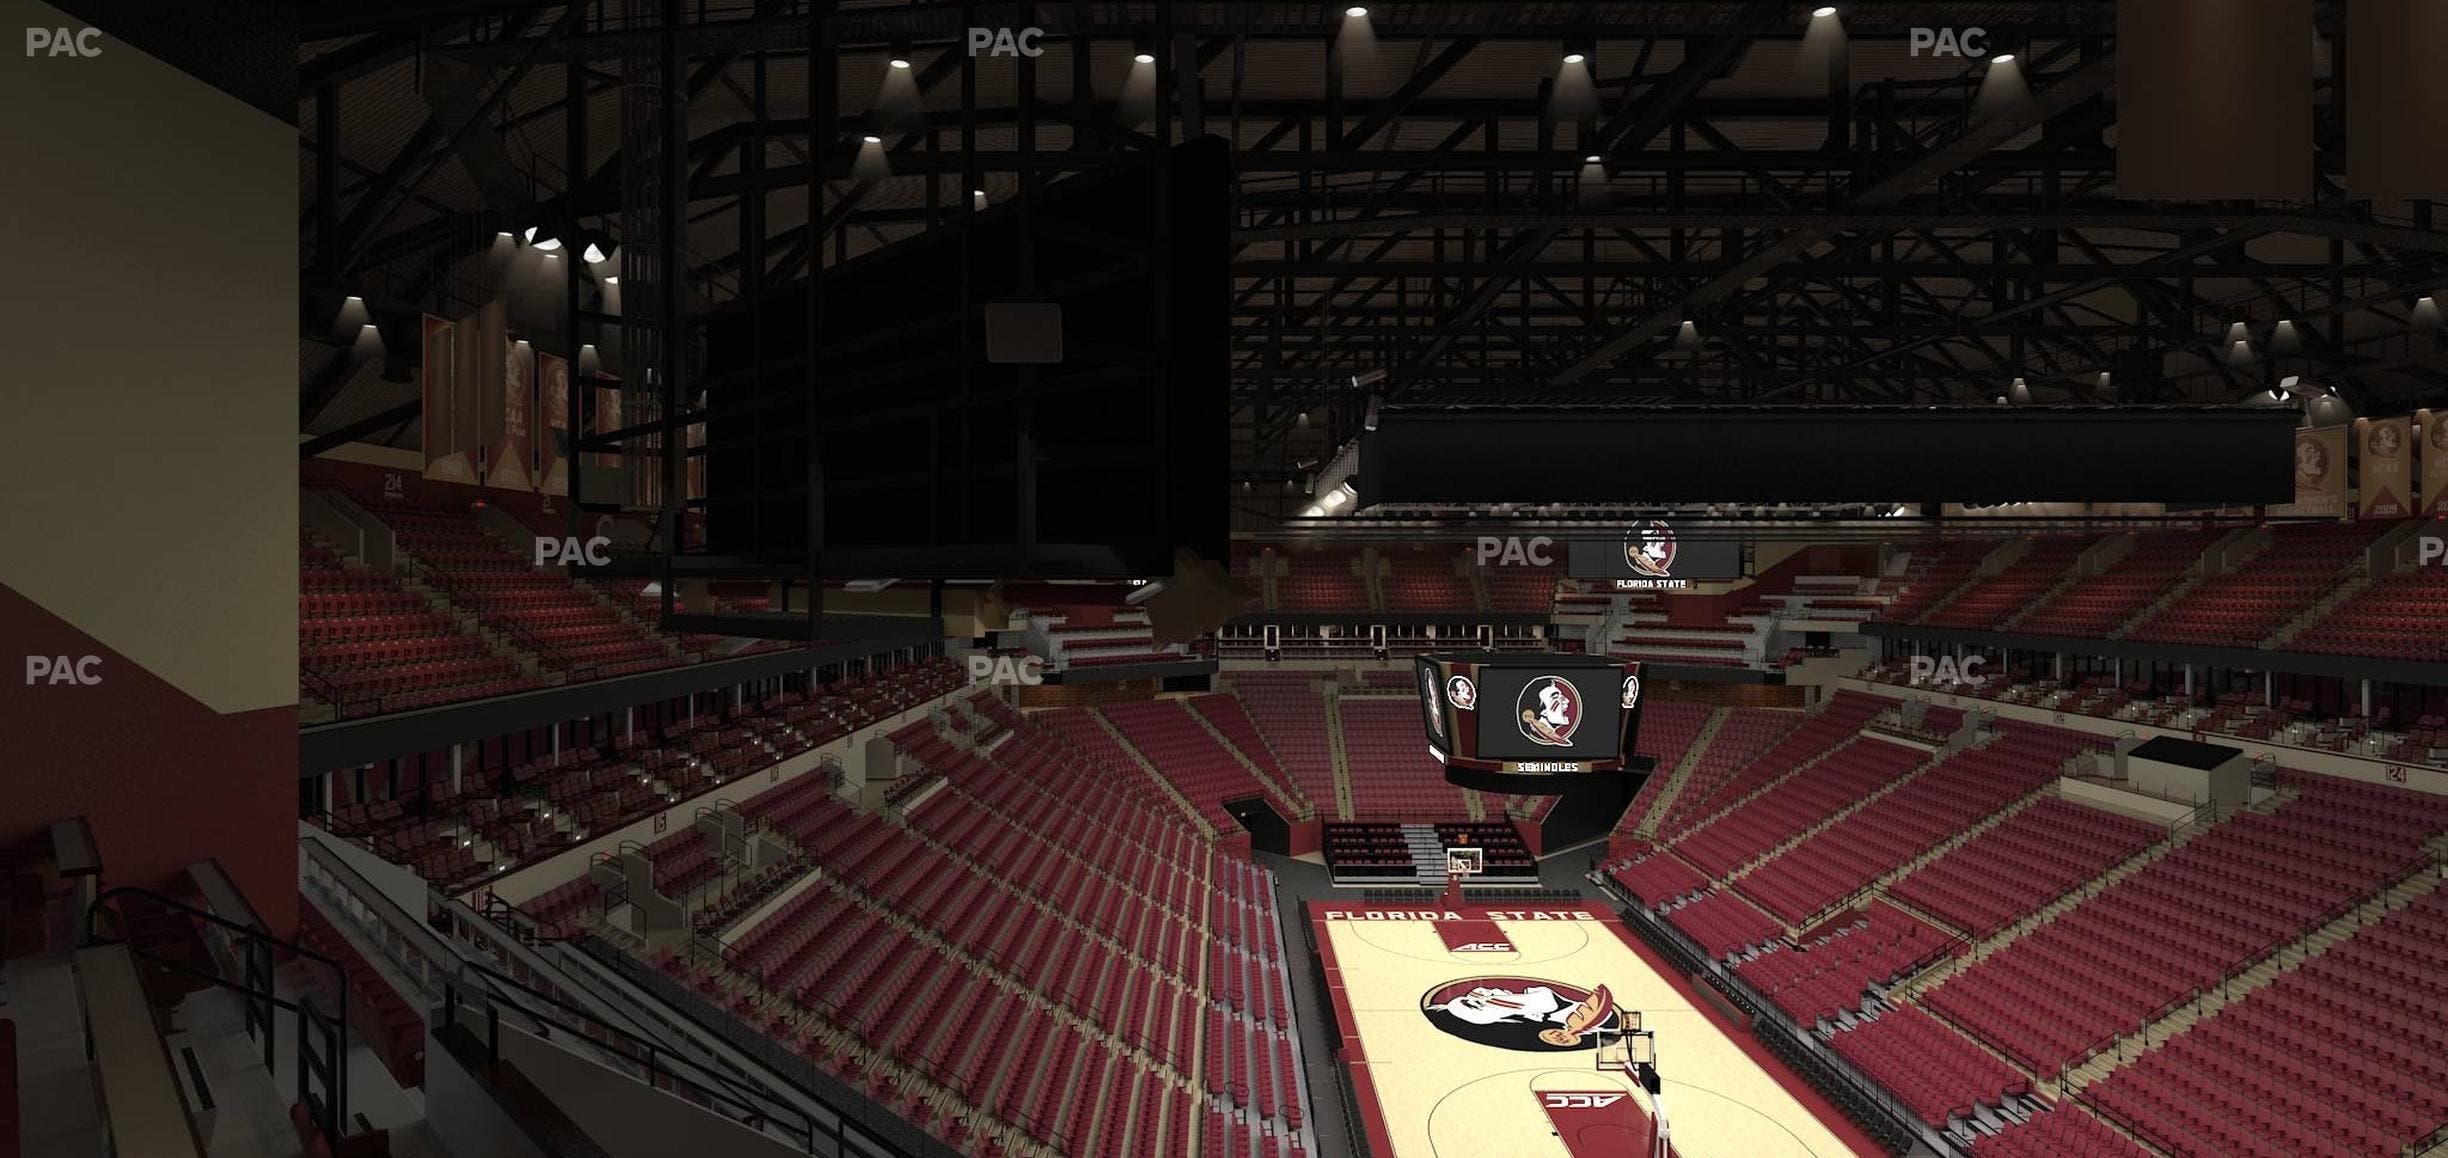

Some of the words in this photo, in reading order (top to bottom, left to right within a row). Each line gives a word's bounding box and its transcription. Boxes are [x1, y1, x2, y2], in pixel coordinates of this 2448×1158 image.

[1616, 580, 1654, 589] FLORIDA
[1656, 580, 1686, 589] STATE
[1517, 762, 1579, 772] SEMINOLES
[1324, 911, 1463, 921] FLORIDA
[1486, 911, 1596, 921] STATE
[1453, 943, 1510, 952] ACC
[1546, 1093, 1628, 1108] ACC
